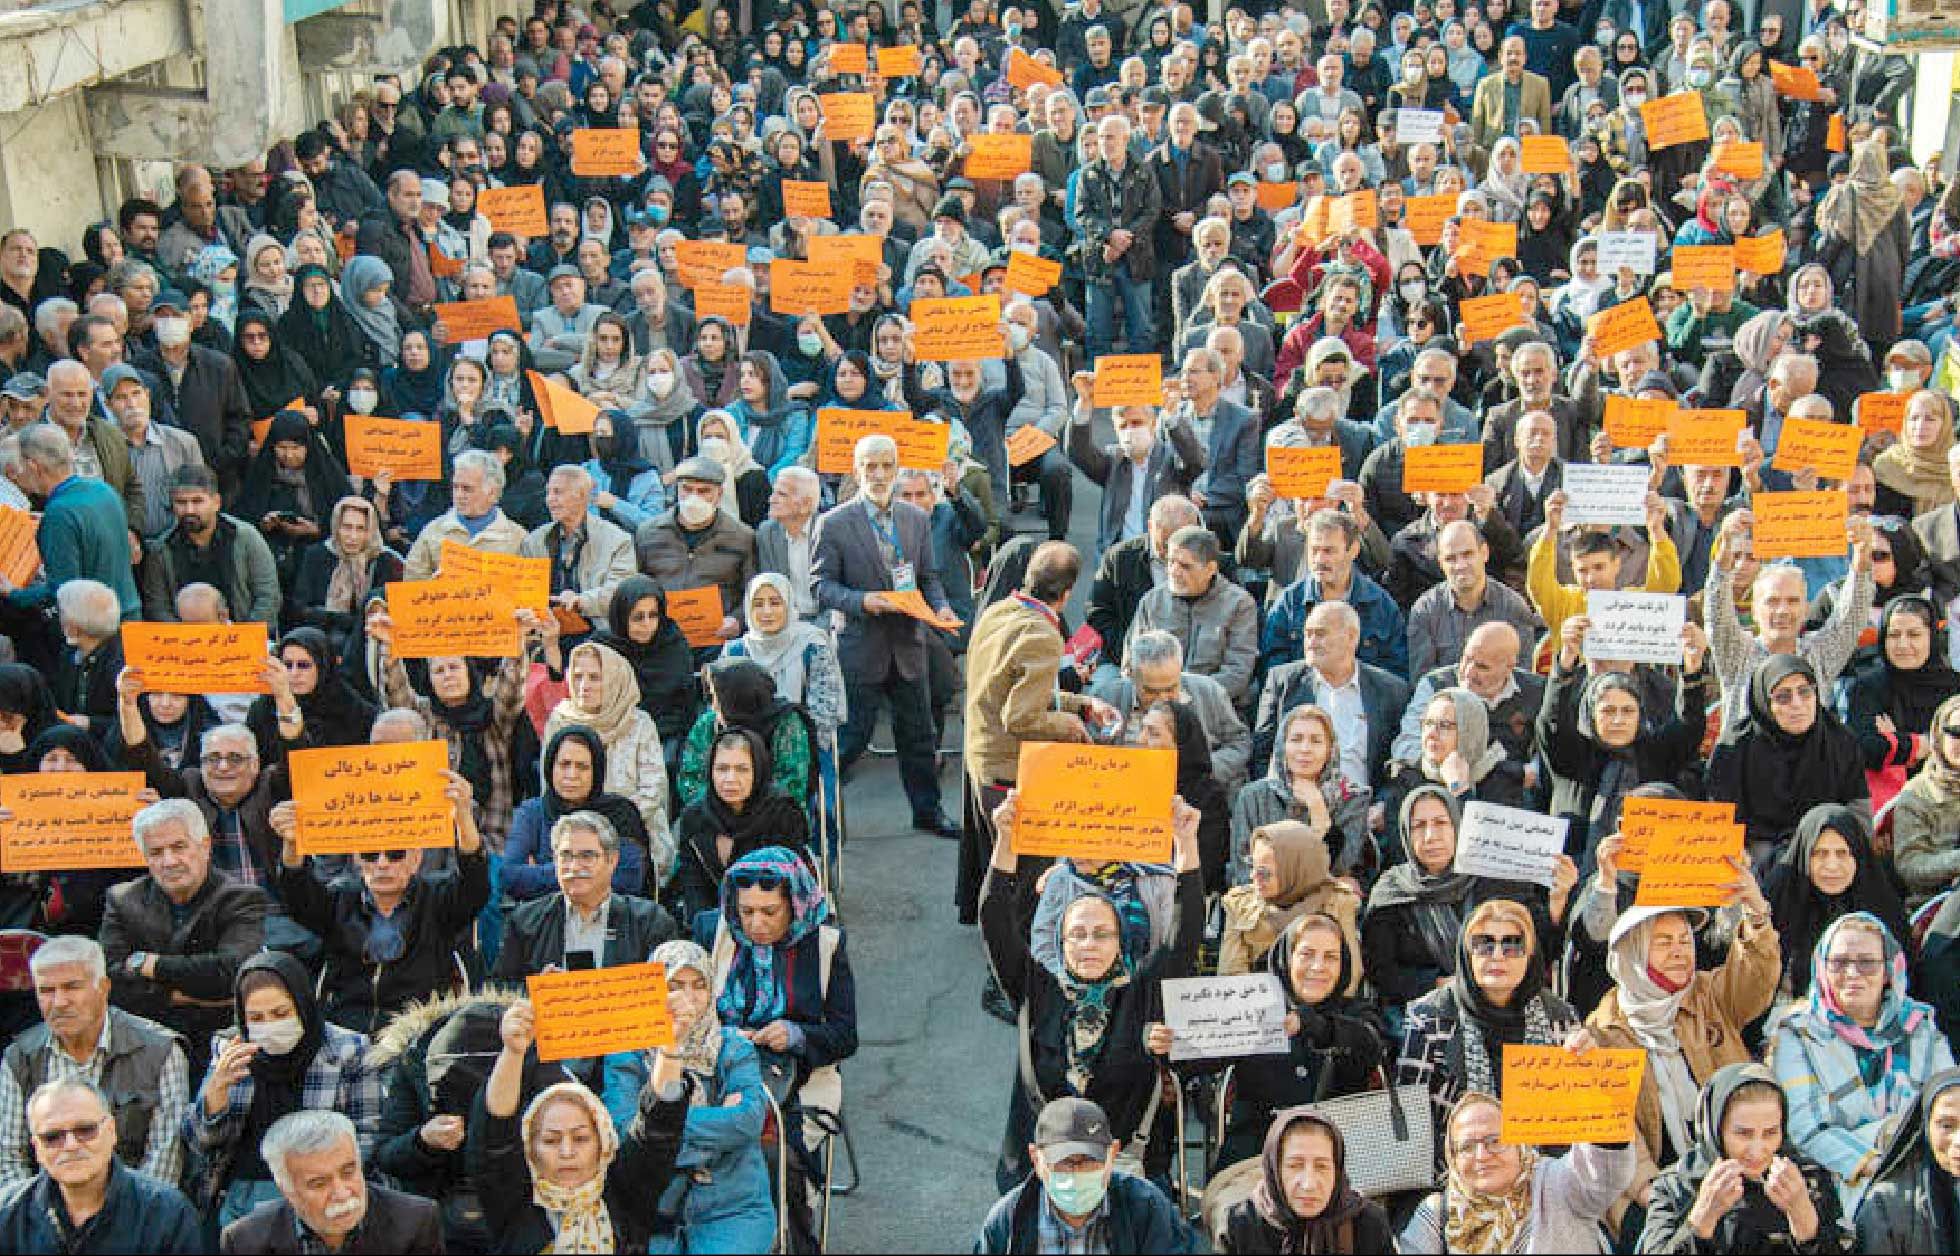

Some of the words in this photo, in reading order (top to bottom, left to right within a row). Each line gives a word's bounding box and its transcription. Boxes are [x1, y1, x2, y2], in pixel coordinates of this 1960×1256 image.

[323, 759, 362, 779] ریالی
[363, 759, 379, 771] ما
[368, 789, 382, 804] ها
[387, 790, 422, 807] هزینه
[1214, 988, 1237, 1001] خود
